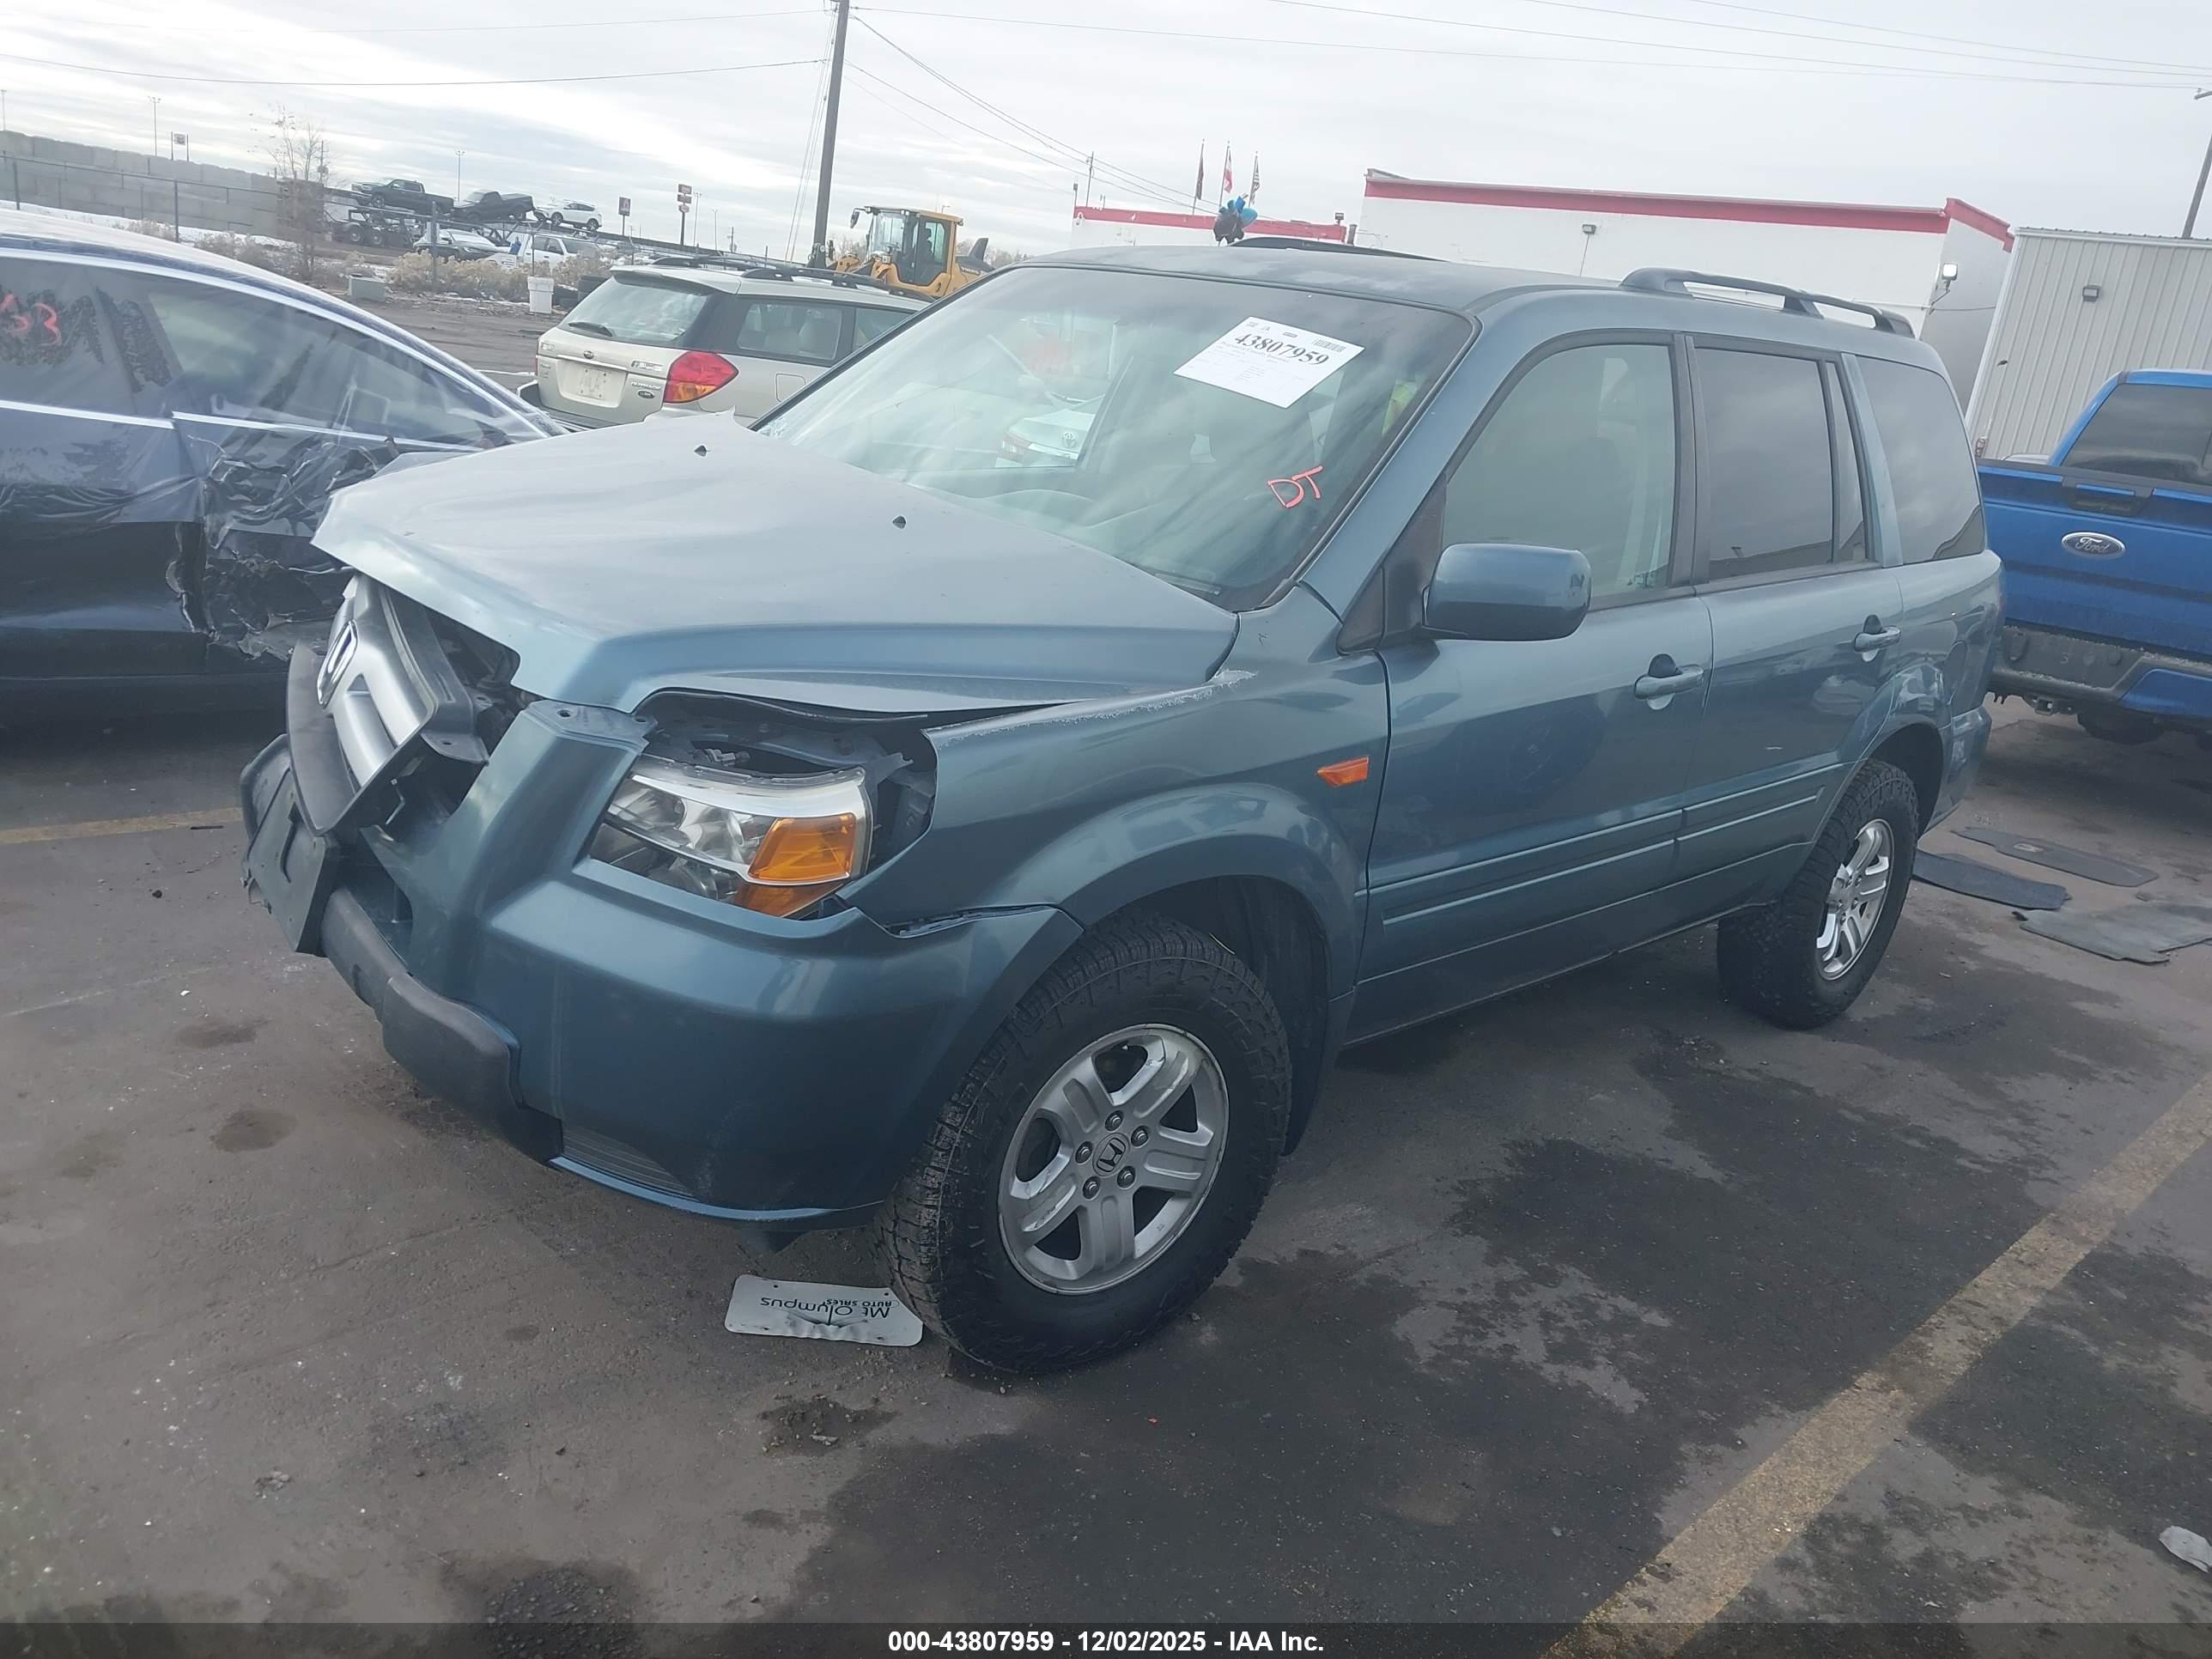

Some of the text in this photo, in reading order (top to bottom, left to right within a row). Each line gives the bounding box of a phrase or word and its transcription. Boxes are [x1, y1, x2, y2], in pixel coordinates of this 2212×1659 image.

[1234, 333, 1330, 365] 43807959
[1267, 465, 1323, 508] DT
[2075, 537, 2111, 553] Ford
[760, 1297, 890, 1326] Mt Olympus
[826, 1298, 858, 1307] SALES
